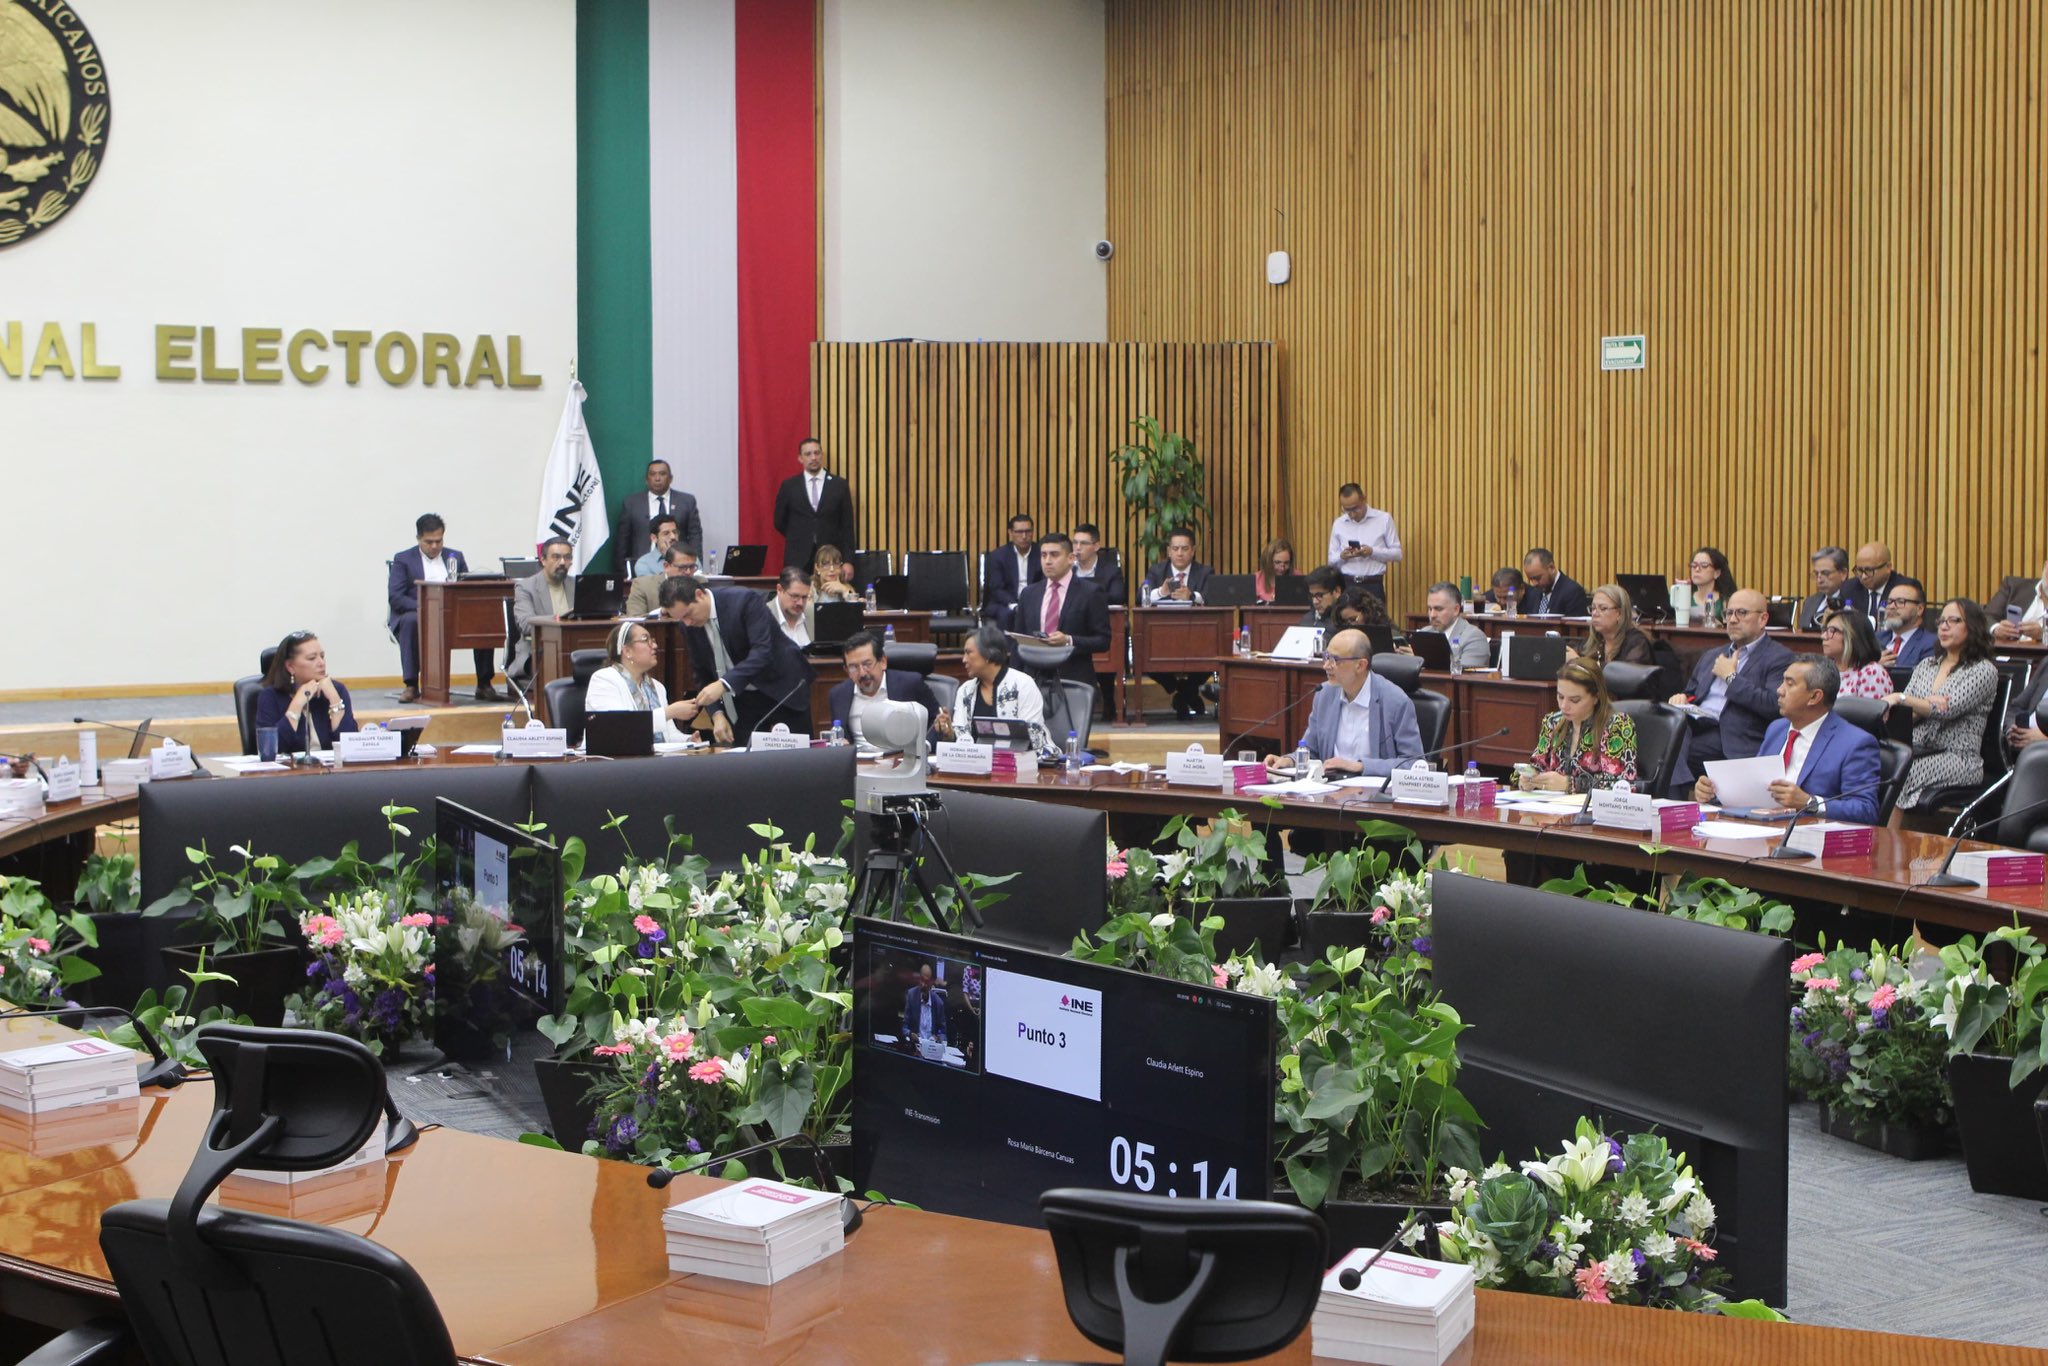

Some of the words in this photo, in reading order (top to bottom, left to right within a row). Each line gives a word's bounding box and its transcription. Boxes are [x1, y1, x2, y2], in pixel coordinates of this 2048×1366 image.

[155, 324, 542, 388] ELECTORAL
[1071, 998, 1093, 1012] INE
[1018, 1022, 1055, 1046] Punto
[1059, 1032, 1066, 1048] 3
[1146, 1057, 1167, 1069] Claudia
[1184, 1066, 1204, 1078] Espino
[1007, 1137, 1019, 1148] Rosa
